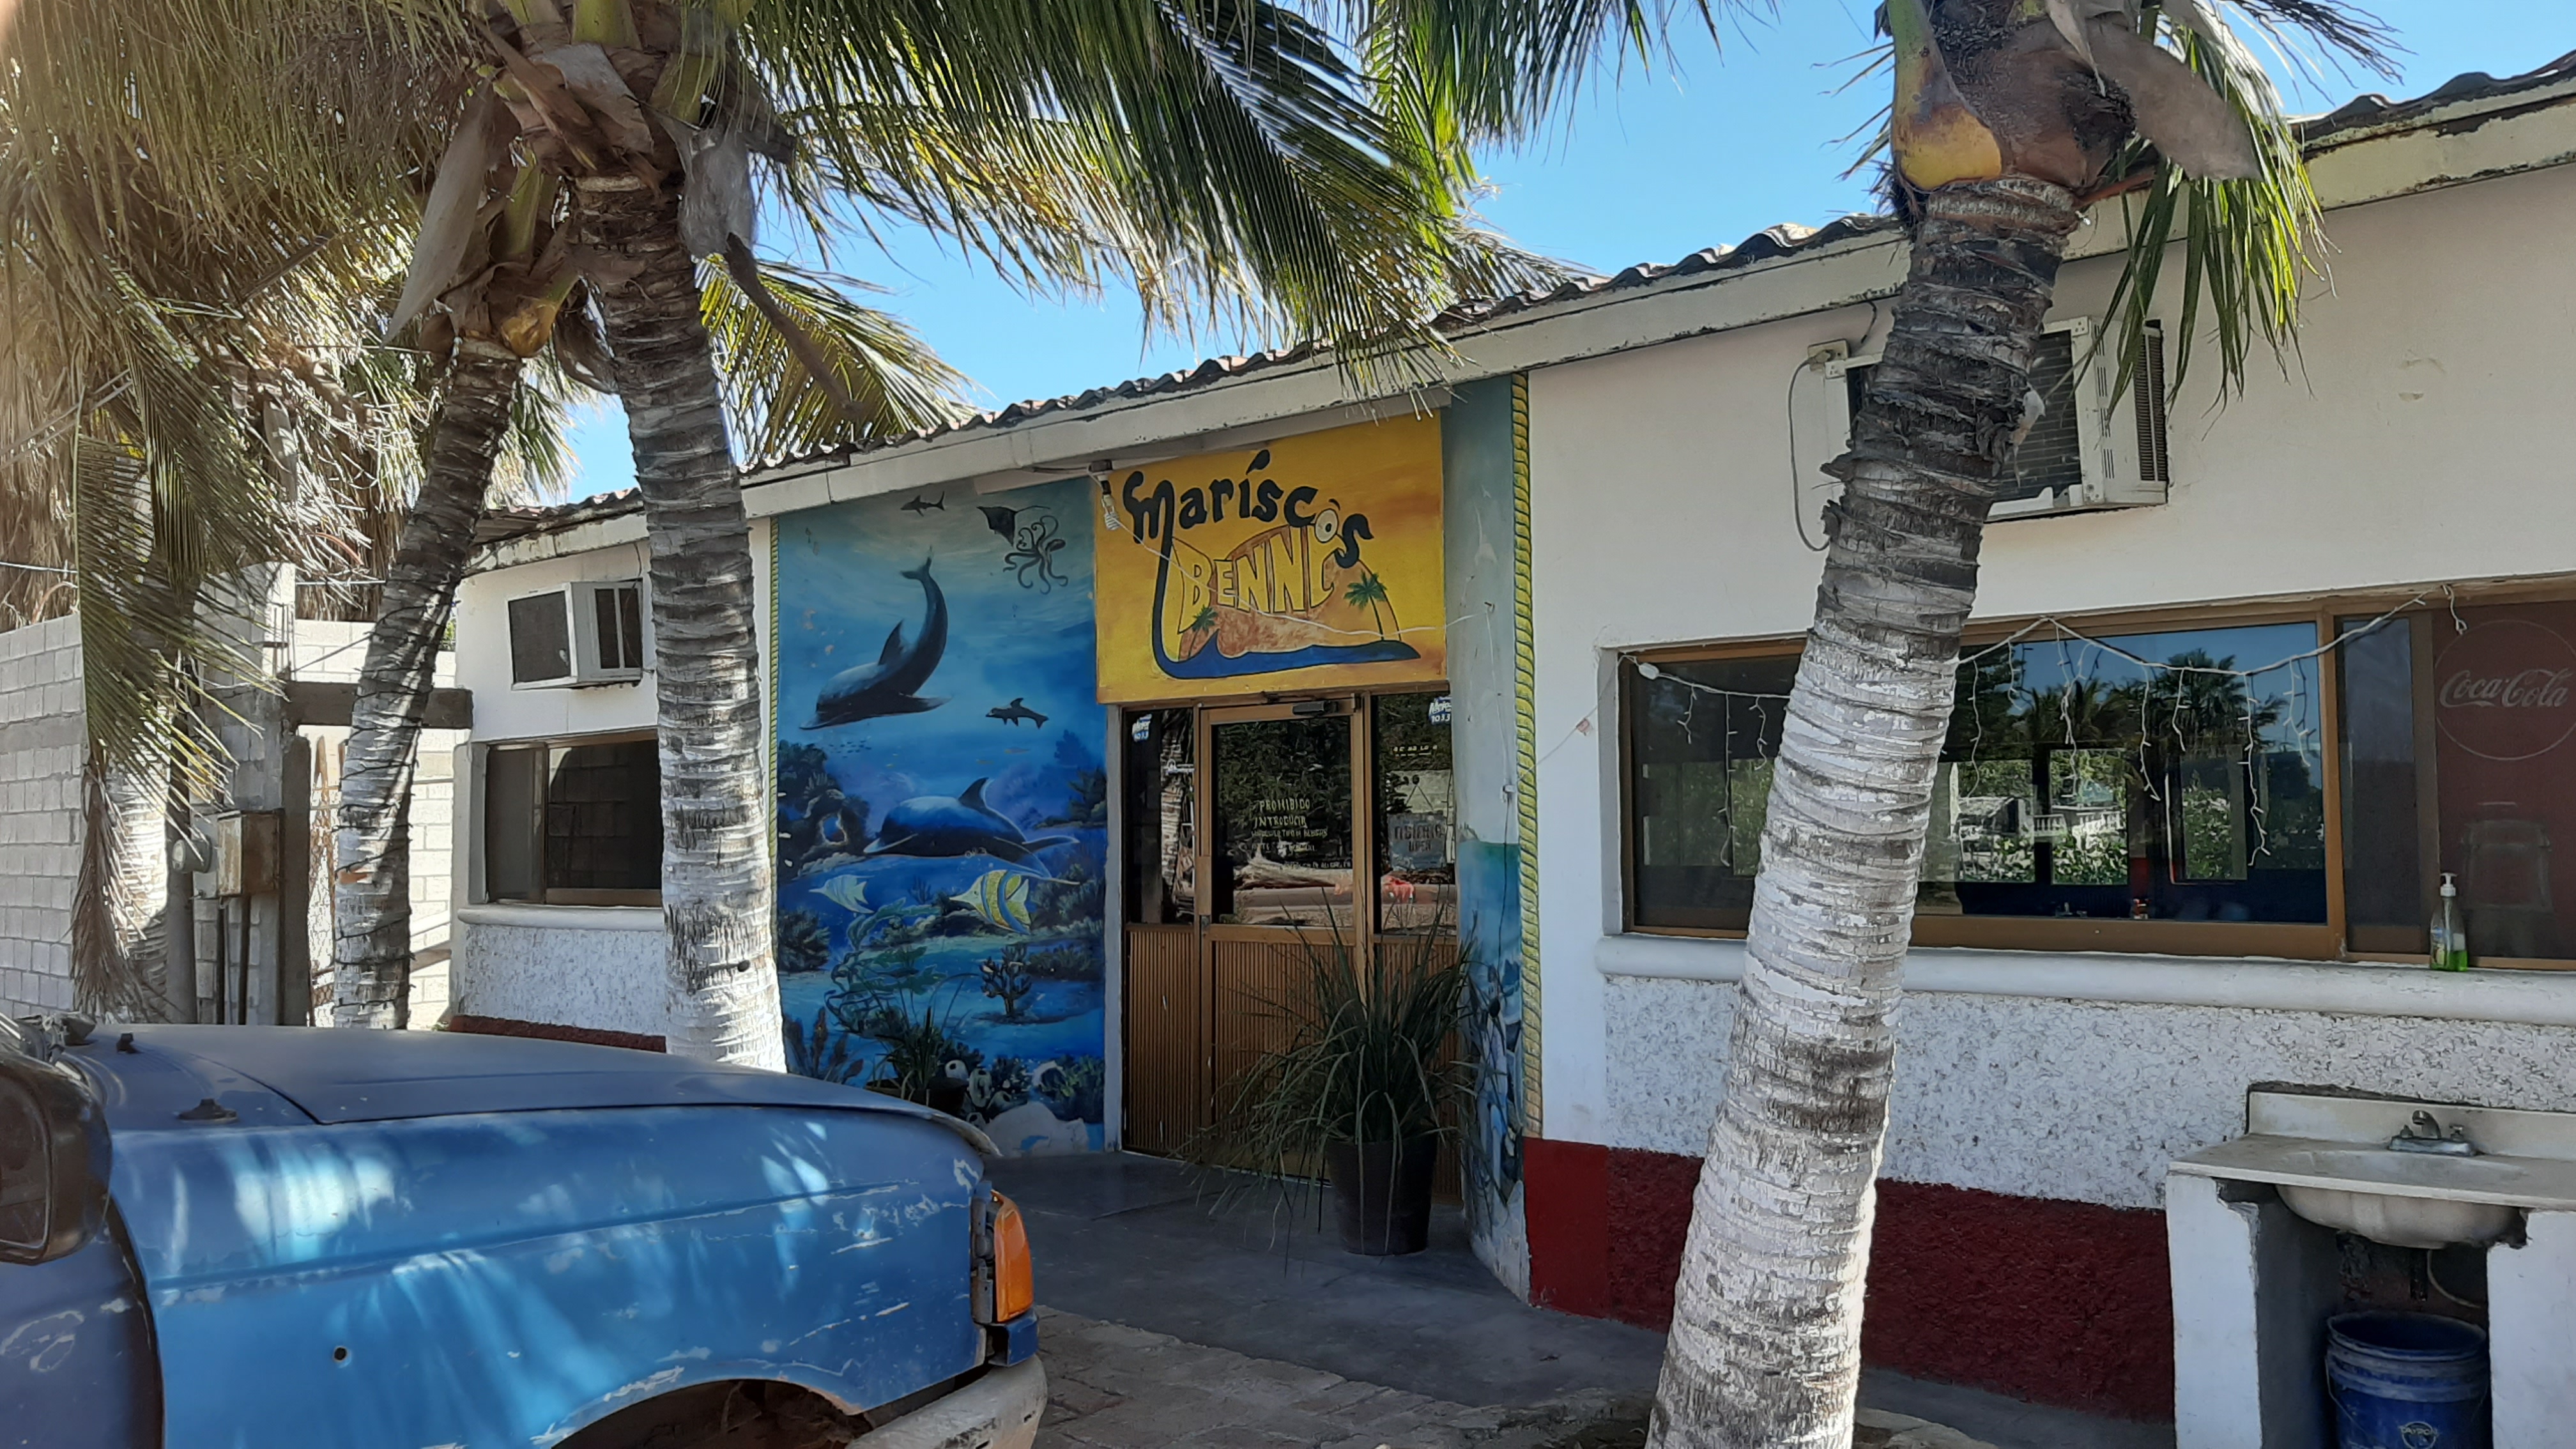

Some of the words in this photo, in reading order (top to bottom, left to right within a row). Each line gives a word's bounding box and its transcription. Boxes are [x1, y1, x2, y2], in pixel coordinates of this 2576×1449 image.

[2439, 669, 2573, 708] Coca-Cola
[1259, 797, 1310, 813] PROHIBIDO
[1254, 814, 1308, 829] INTRODUCIR
